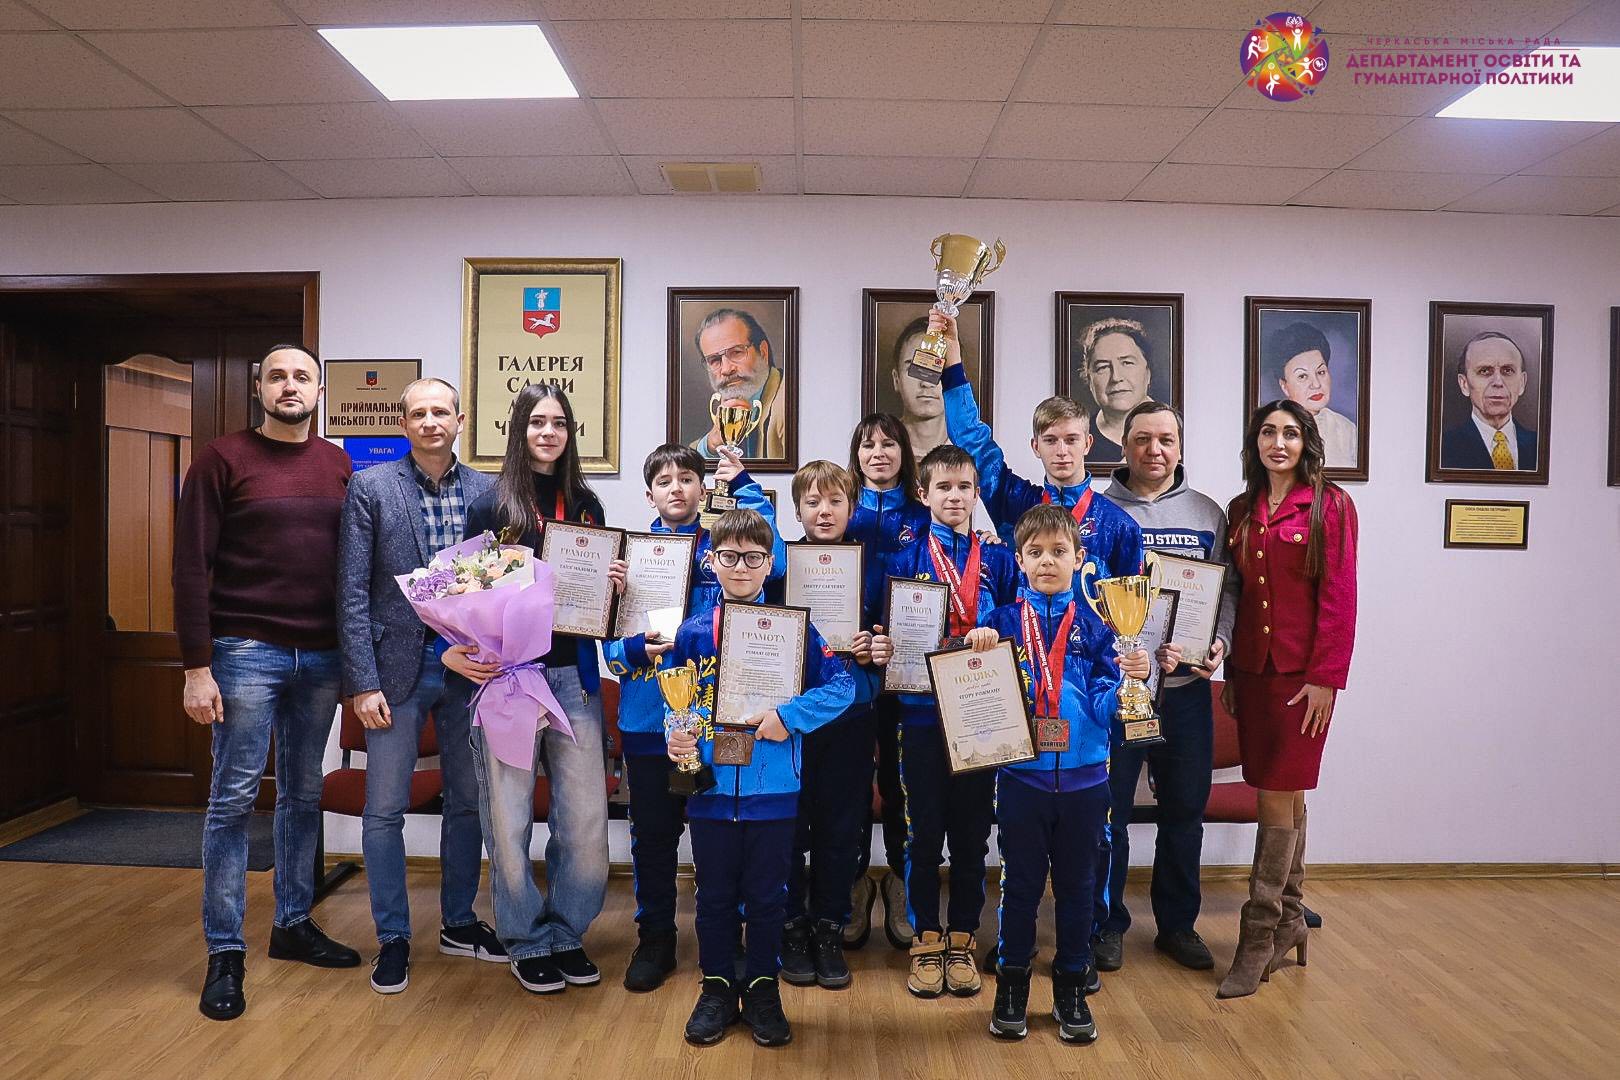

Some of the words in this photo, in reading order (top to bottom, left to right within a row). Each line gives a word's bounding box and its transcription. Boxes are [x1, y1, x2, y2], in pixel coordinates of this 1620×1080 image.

[498, 355, 584, 372] ГАЛЕРЕЯ
[340, 400, 402, 413] ПРИЙМАЛЬНЯ
[329, 415, 375, 426] МІСЬКОГО
[379, 415, 401, 426] ГОЛО
[1155, 533, 1199, 546] STATES
[560, 547, 601, 560] ГРАМОТА
[640, 557, 676, 567] ГРАМОТА
[804, 566, 845, 576] ПОДЯКА
[901, 605, 932, 615] ГРАМОТА
[741, 631, 786, 643] ГРАМОТА
[954, 669, 998, 684] ПОДЯКА
